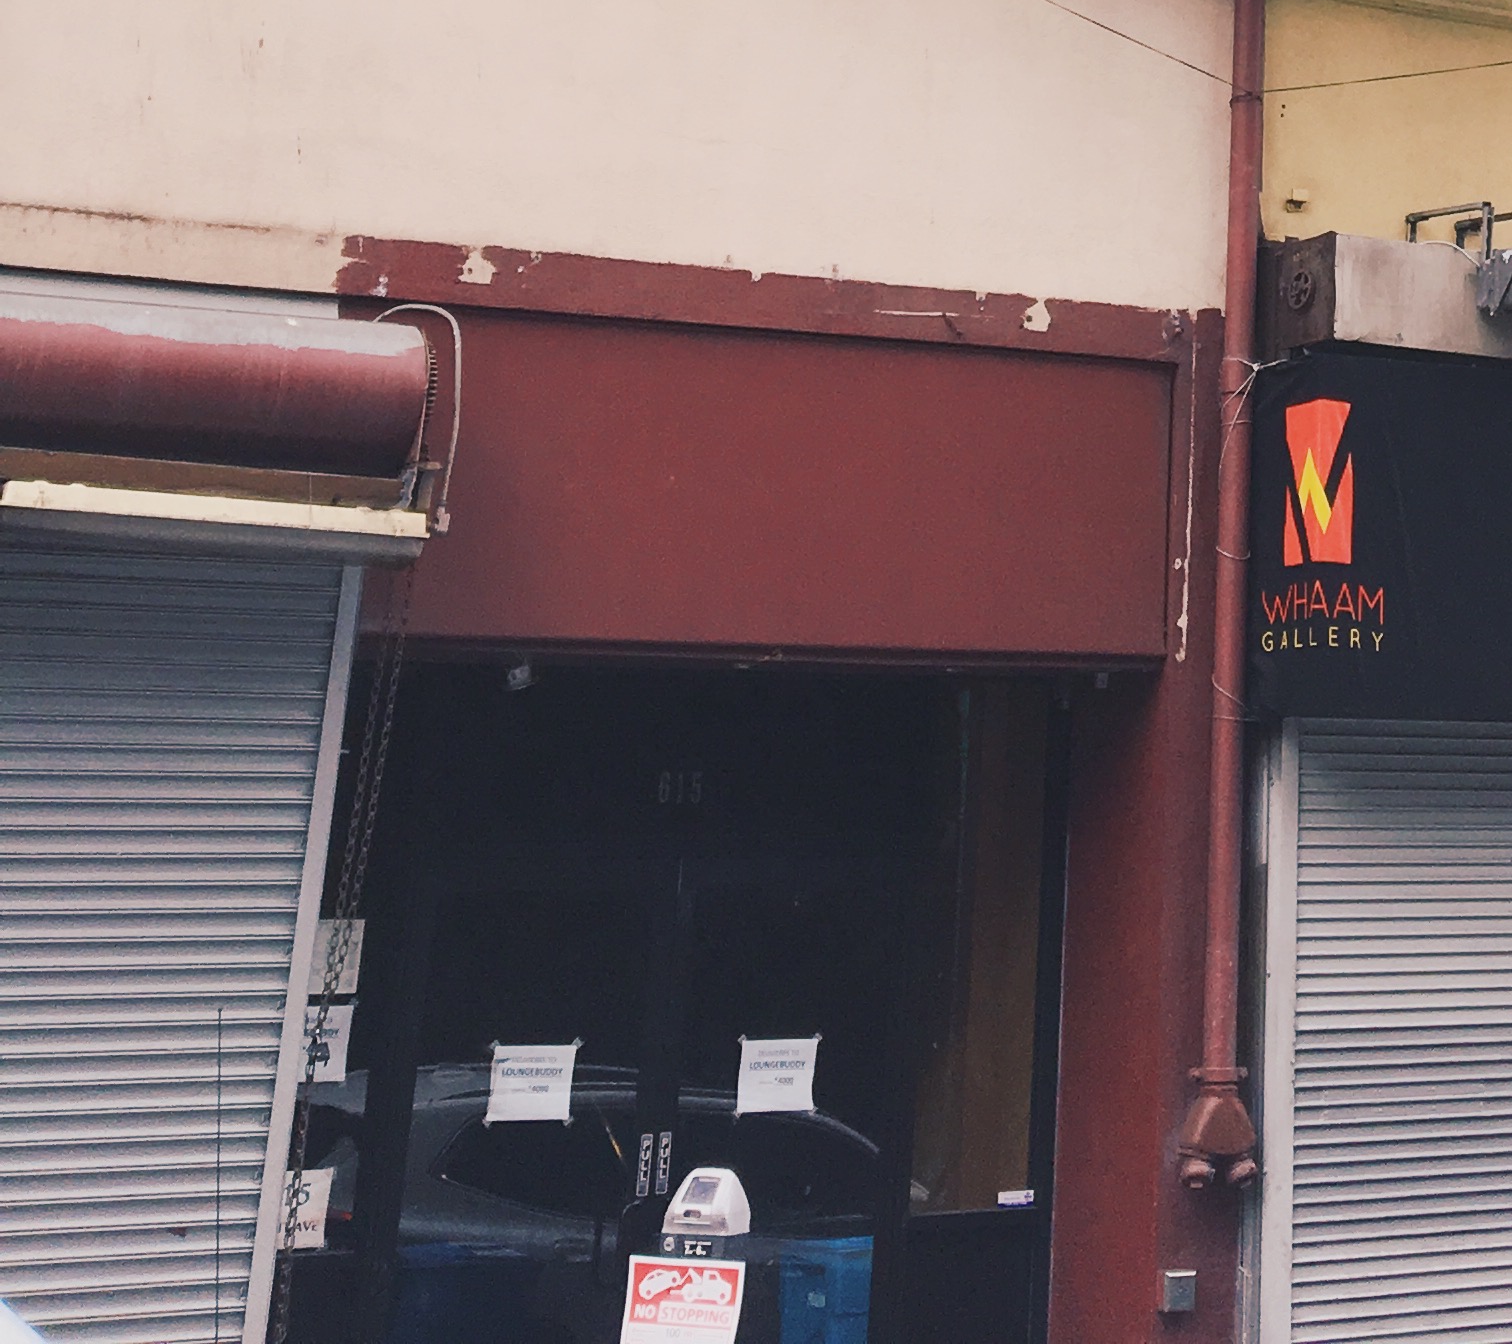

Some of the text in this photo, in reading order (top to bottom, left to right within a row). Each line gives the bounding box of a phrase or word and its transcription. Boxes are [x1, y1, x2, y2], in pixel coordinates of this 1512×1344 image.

[1261, 579, 1384, 625] WHAAM
[1261, 626, 1384, 652] GALLERY
[640, 1139, 652, 1182] PULL
[659, 1137, 671, 1179] PULL
[633, 1303, 731, 1324] NO STOPPING
